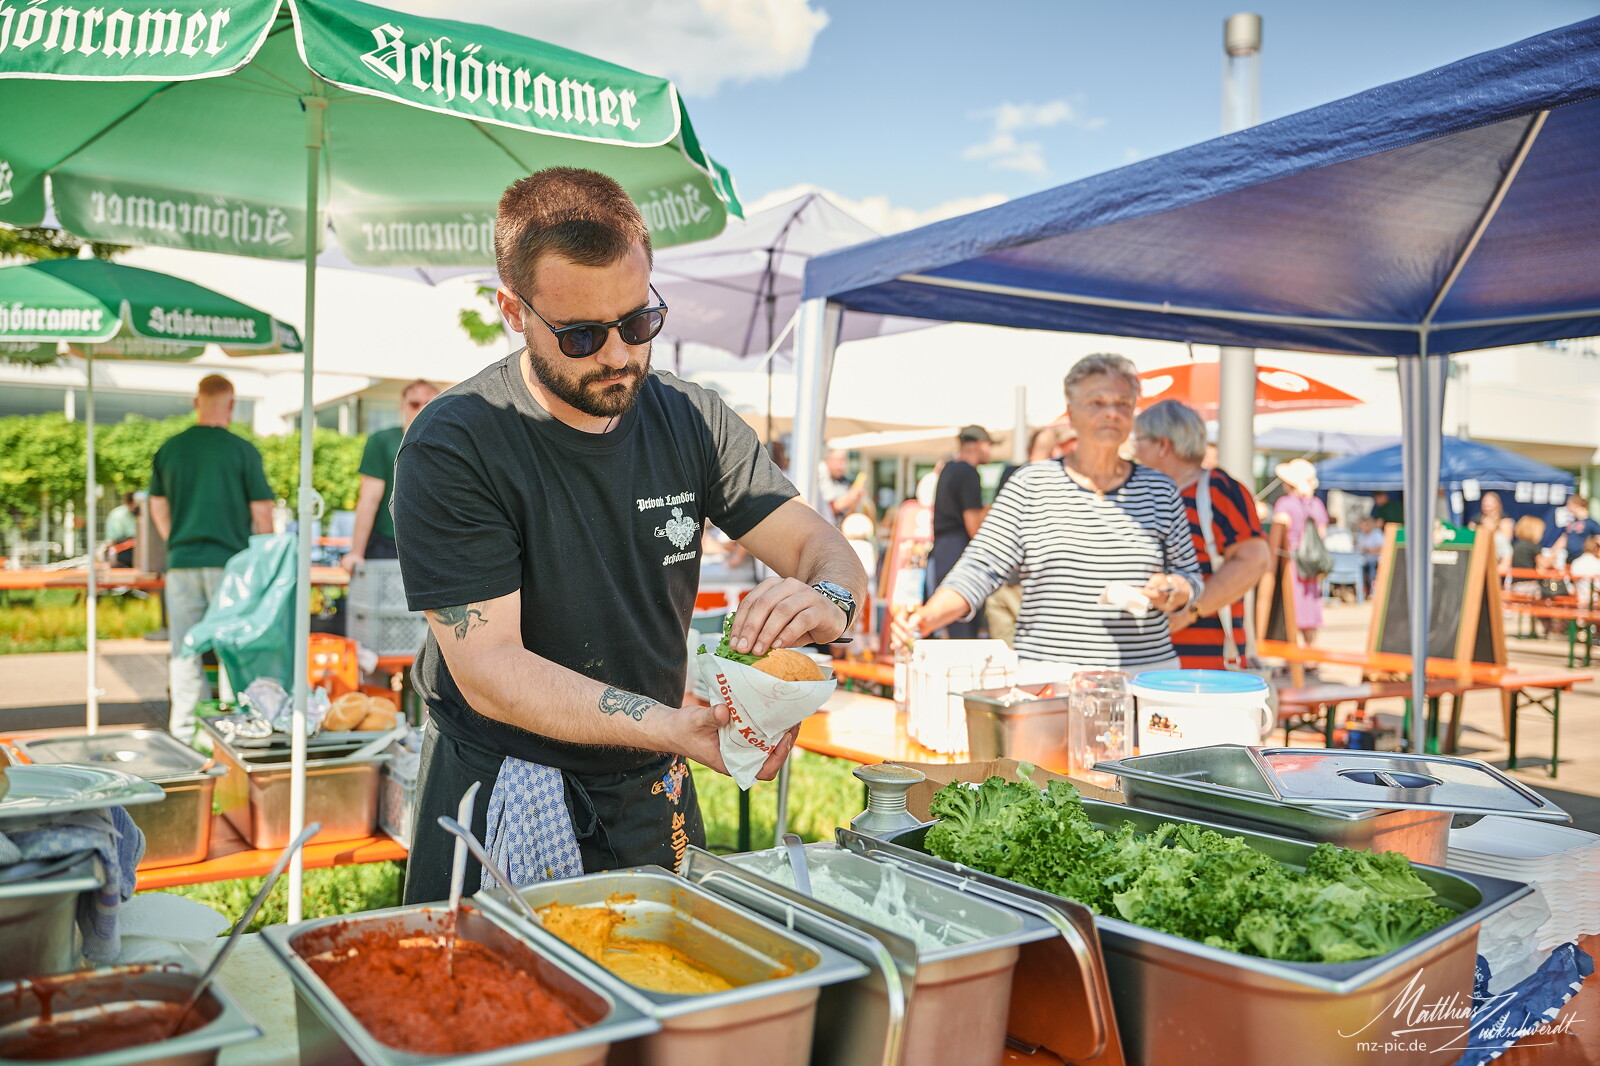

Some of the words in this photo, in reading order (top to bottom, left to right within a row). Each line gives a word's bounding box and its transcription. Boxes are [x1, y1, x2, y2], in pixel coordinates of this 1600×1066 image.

[0, 0, 231, 59] hönramer
[360, 22, 641, 131] Schönramer
[0, 301, 103, 334] hönramer
[148, 306, 257, 339] Schönramer
[716, 673, 743, 723] Döner
